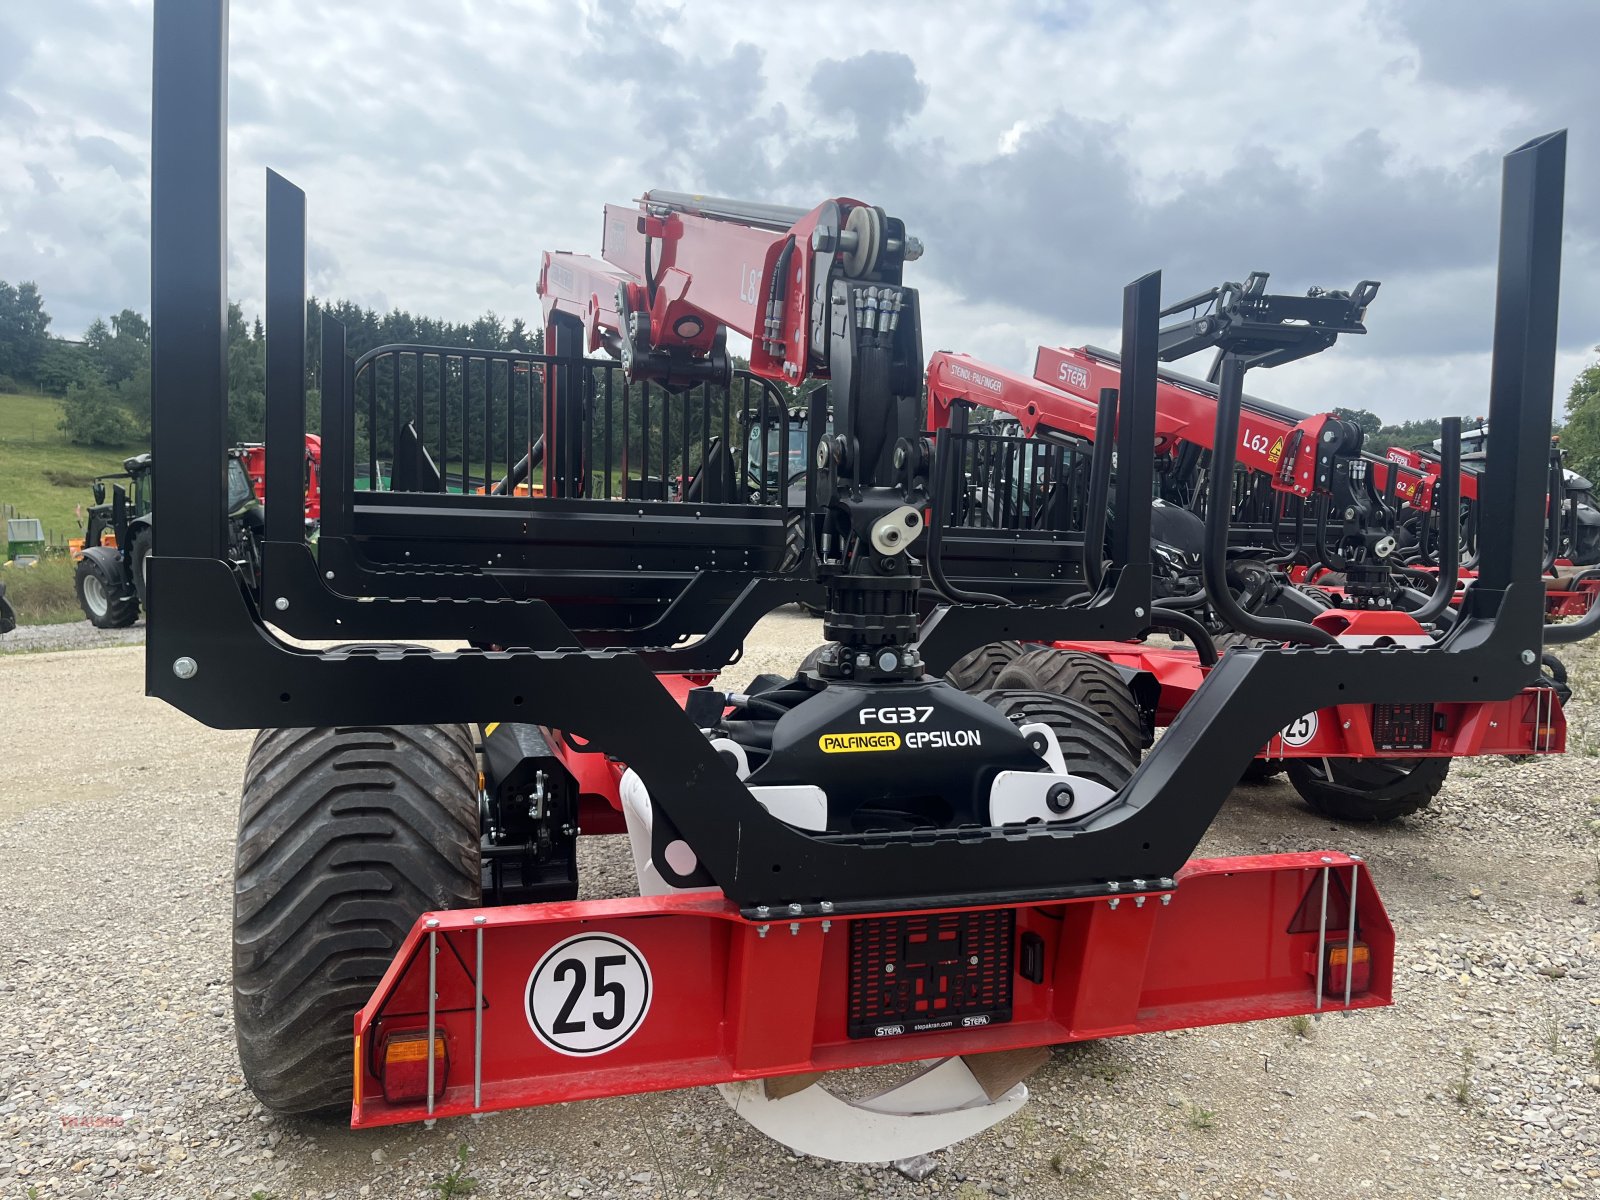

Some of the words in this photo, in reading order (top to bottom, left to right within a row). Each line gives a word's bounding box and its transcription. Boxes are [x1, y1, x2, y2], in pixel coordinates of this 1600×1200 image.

[740, 263, 763, 304] L8
[951, 364, 1002, 392] STEINDL-PALFINGER
[1059, 362, 1087, 389] STEPA
[1242, 429, 1269, 454] L62
[859, 706, 935, 725] FG37
[824, 735, 896, 750] PALFINGER
[905, 729, 982, 749] EPSILON
[552, 954, 627, 1035] 25
[877, 1026, 902, 1036] STEPA
[914, 1021, 953, 1031] stepakran.com
[963, 1016, 988, 1027] STEPA
